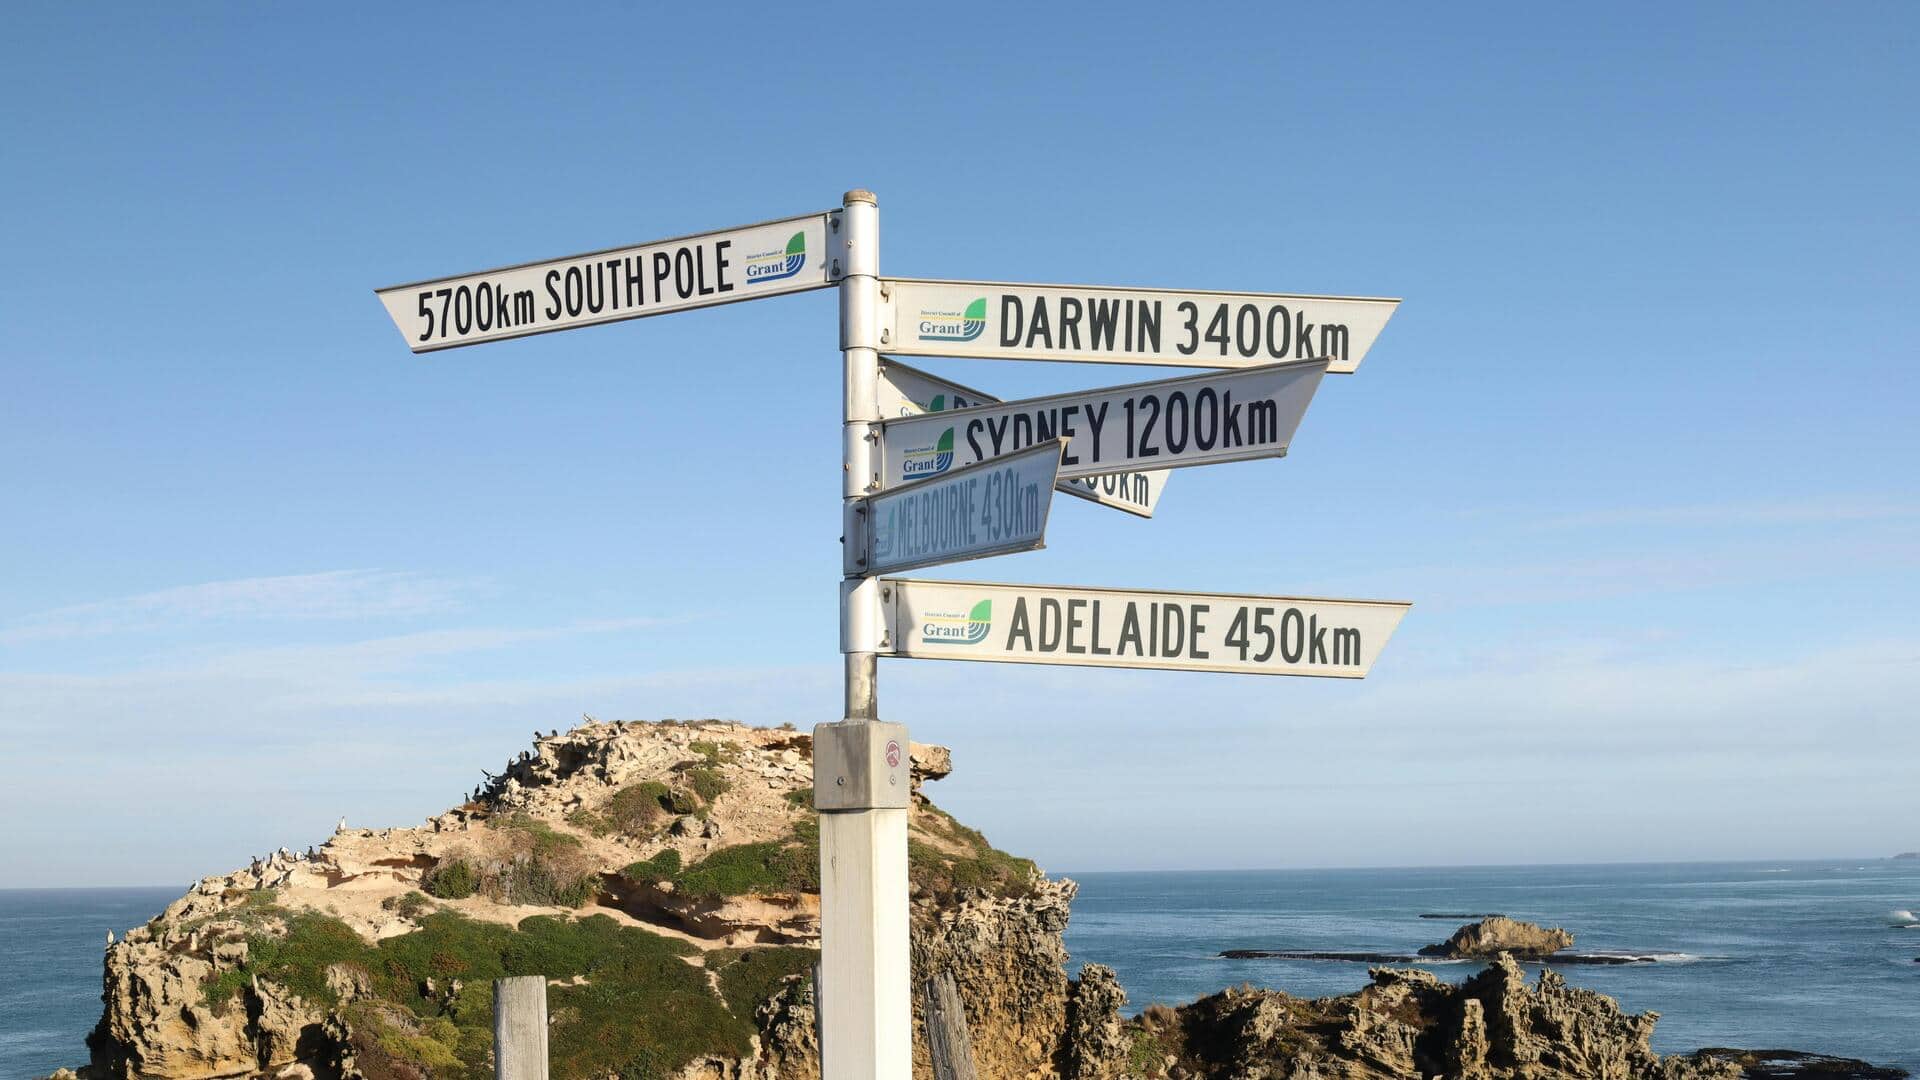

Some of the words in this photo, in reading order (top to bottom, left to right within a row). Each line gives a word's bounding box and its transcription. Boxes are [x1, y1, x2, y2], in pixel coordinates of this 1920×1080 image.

[418, 281, 535, 342] 5700km
[545, 257, 645, 321] SOUTH
[655, 240, 734, 303] POLE
[746, 261, 784, 277] Grant
[919, 321, 962, 335] Grant
[1000, 294, 1162, 353] DARWIN
[1176, 301, 1349, 361] 3400km
[965, 401, 1109, 466] SYDNEY
[1123, 387, 1278, 459] 1200km
[903, 459, 935, 473] Grant
[898, 478, 977, 557] MELBOURNE
[981, 468, 1039, 542] 430km
[923, 623, 966, 637] Grant
[1005, 596, 1211, 659] ADELAIDE
[1224, 606, 1362, 667] 450km
